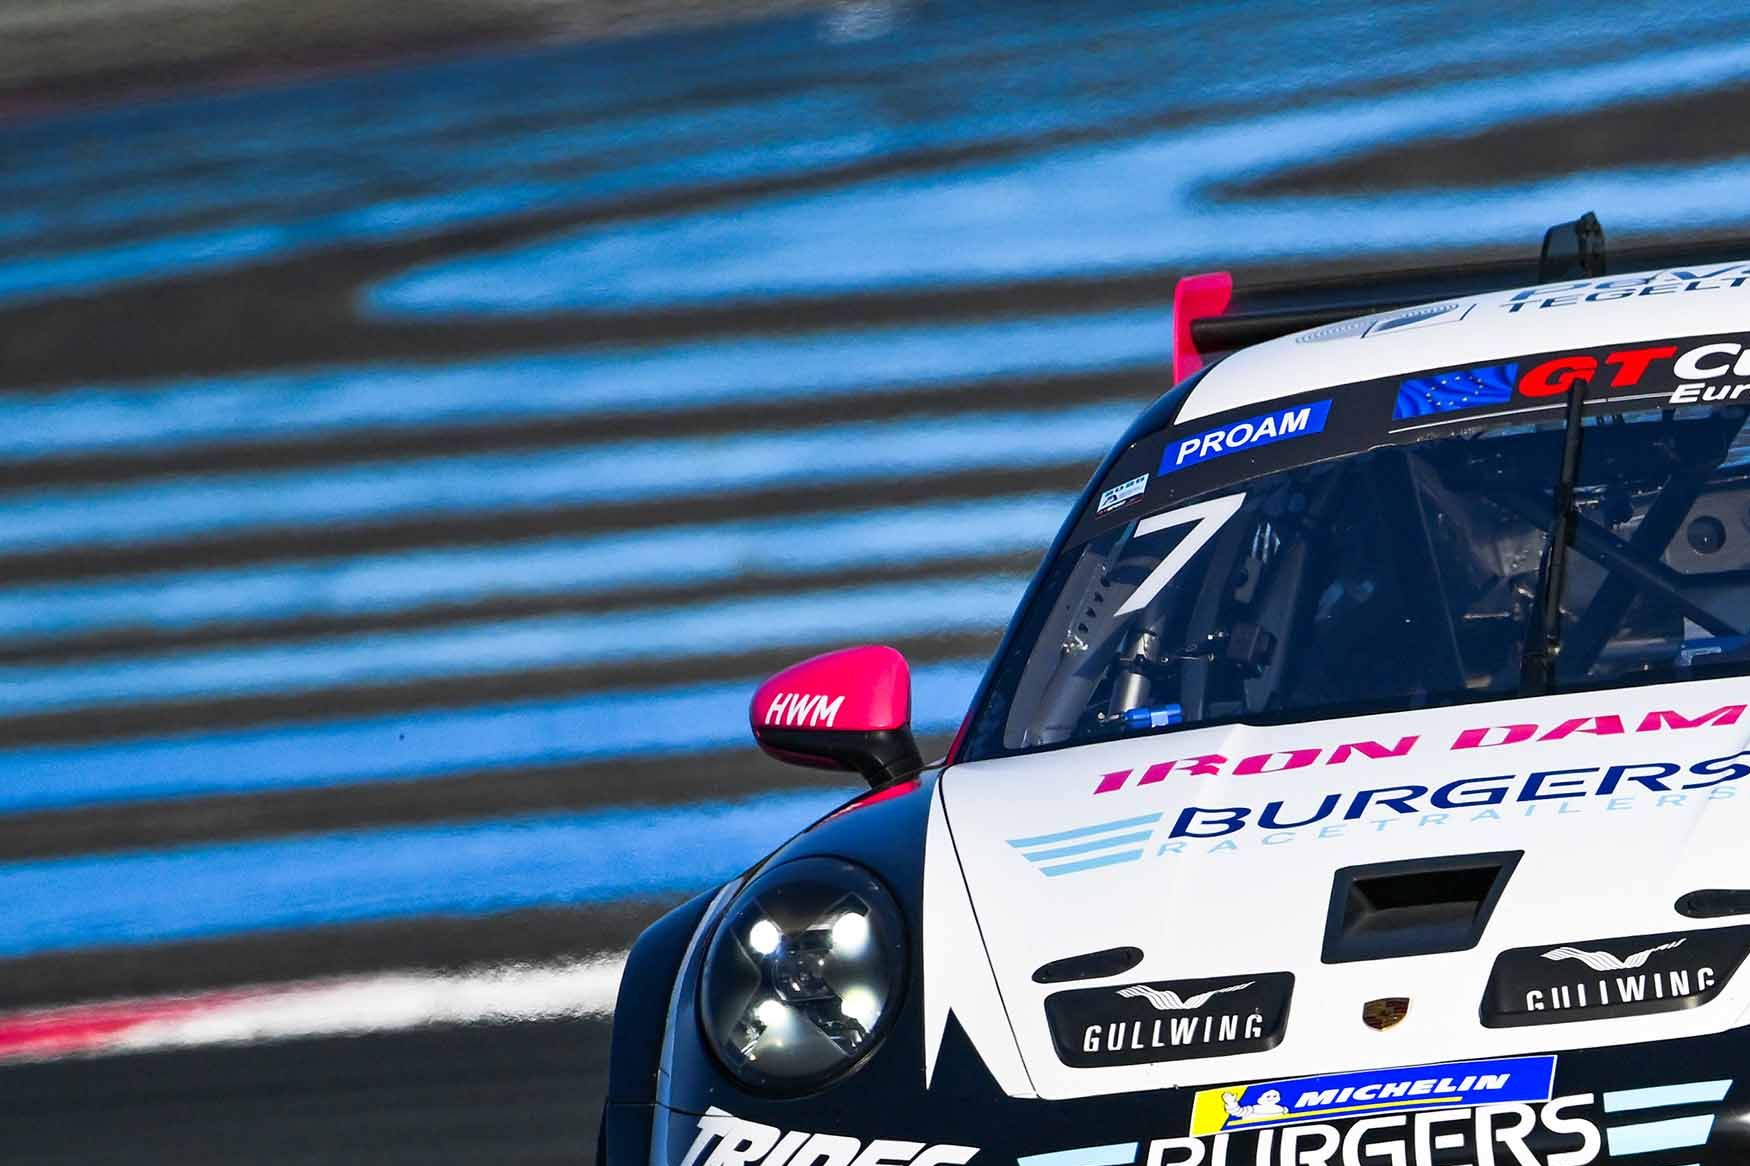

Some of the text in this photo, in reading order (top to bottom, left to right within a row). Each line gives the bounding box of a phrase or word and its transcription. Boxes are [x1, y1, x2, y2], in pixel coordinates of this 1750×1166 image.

[1518, 345, 1677, 397] GT
[1175, 407, 1312, 465] PROAM
[1113, 491, 1248, 617] 7
[764, 692, 846, 728] HWM
[1092, 734, 1421, 795] IRON
[1156, 785, 1738, 857] RACETRAILERS
[1083, 1013, 1264, 1053] GULLWING
[1295, 1072, 1512, 1109] MICHELIN
